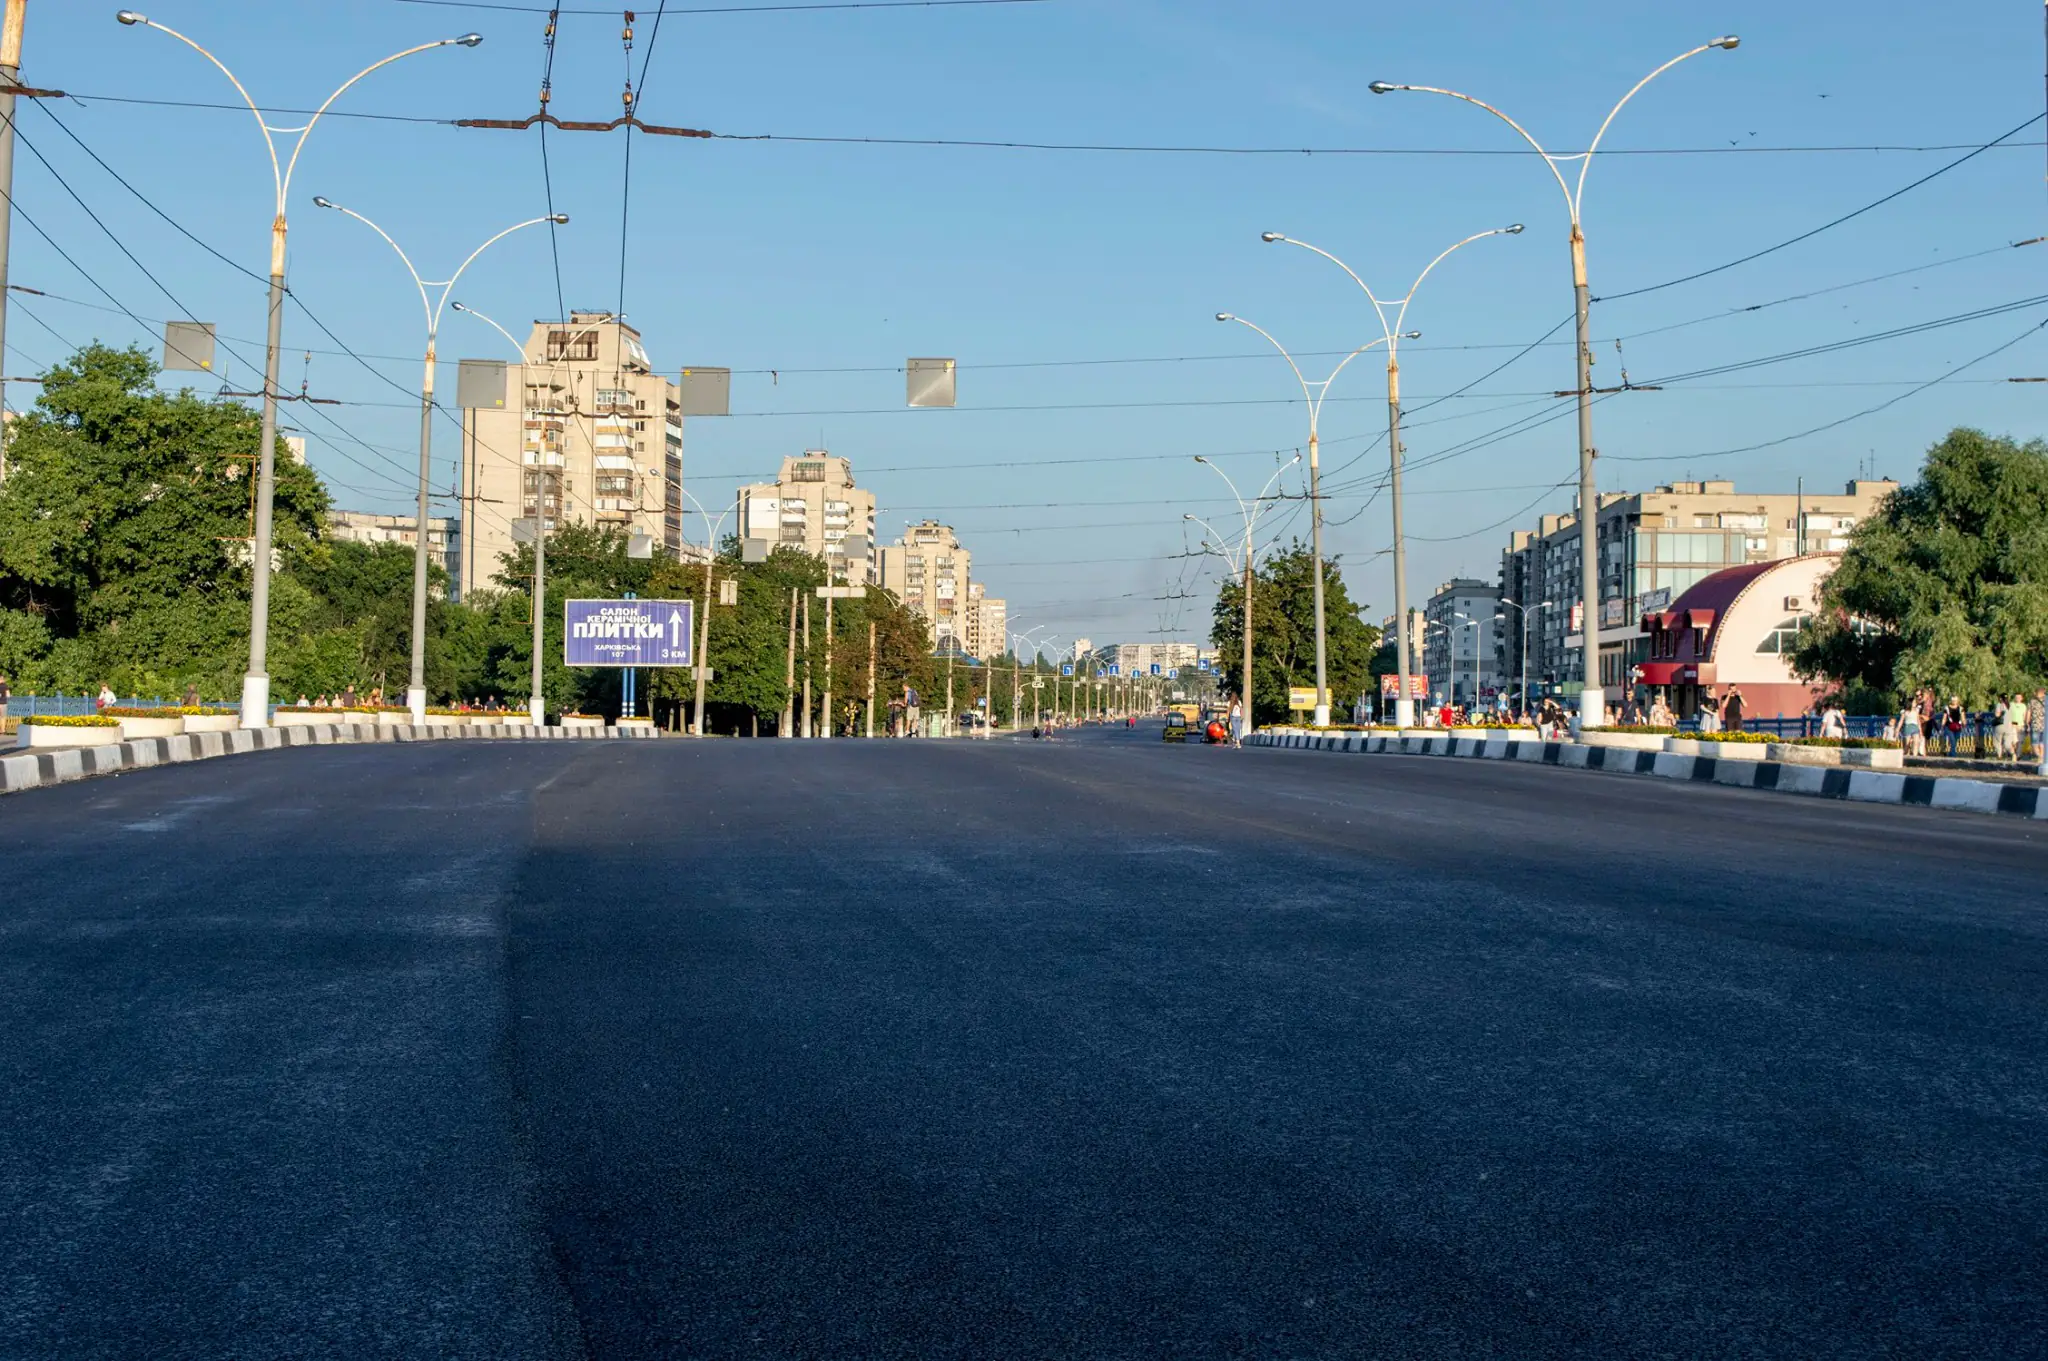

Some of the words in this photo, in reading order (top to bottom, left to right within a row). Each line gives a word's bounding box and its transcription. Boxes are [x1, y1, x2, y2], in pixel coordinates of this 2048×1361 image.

[600, 608, 638, 616] САЛОН
[587, 614, 651, 623] КЕРАМІЧНОЇ
[573, 623, 664, 638] ПЛИТКИ
[662, 649, 669, 658] 3
